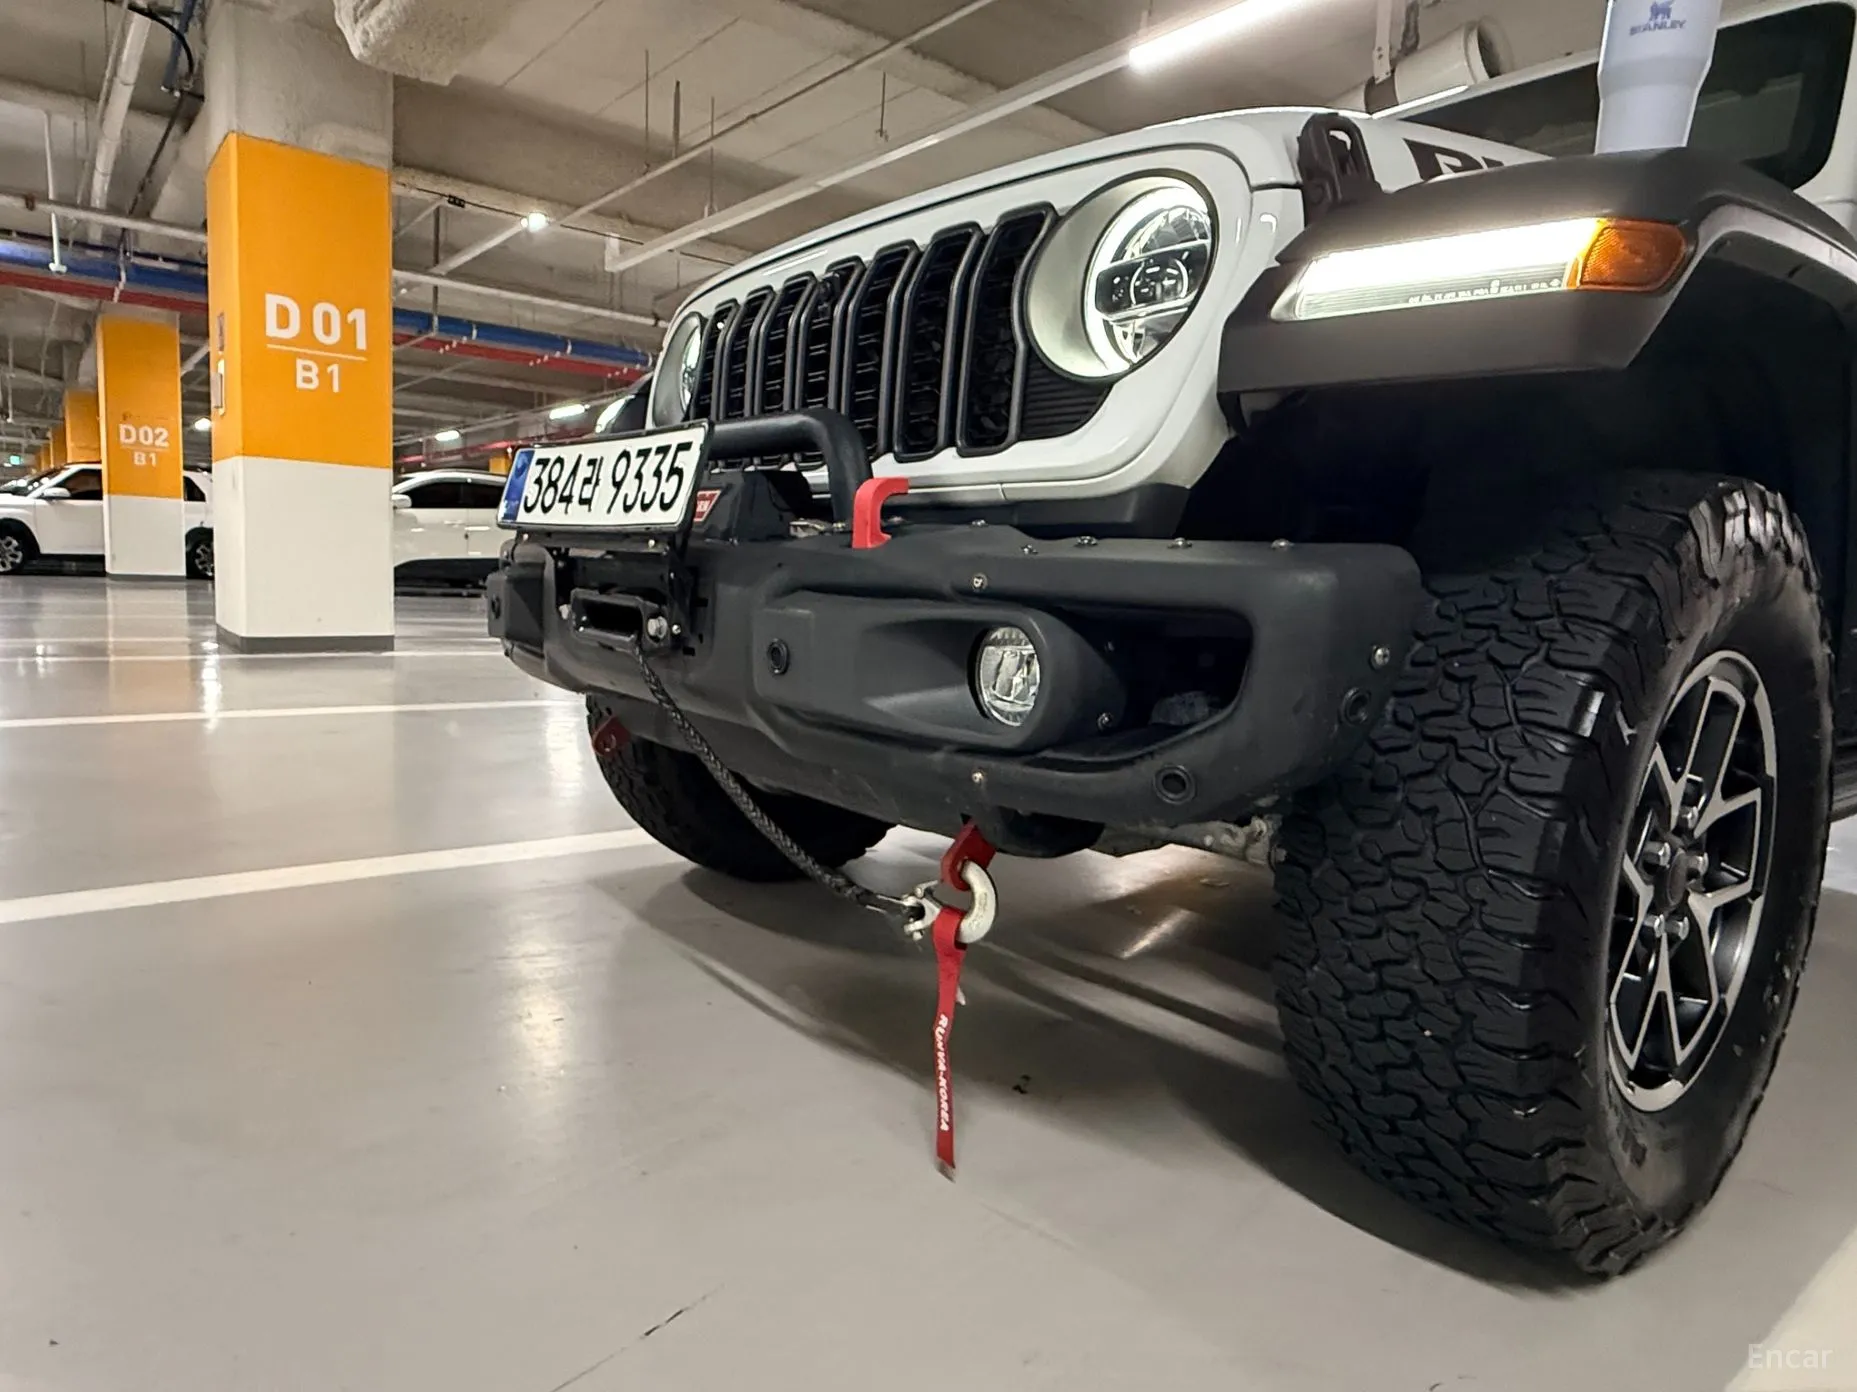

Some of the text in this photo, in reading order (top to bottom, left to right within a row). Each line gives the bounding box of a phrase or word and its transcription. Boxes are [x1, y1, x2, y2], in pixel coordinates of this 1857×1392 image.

[118, 423, 170, 448] D02
[133, 451, 157, 468] B1
[523, 441, 693, 515] 384라 9335
[934, 1013, 950, 1131] RUNVA-KOREA
